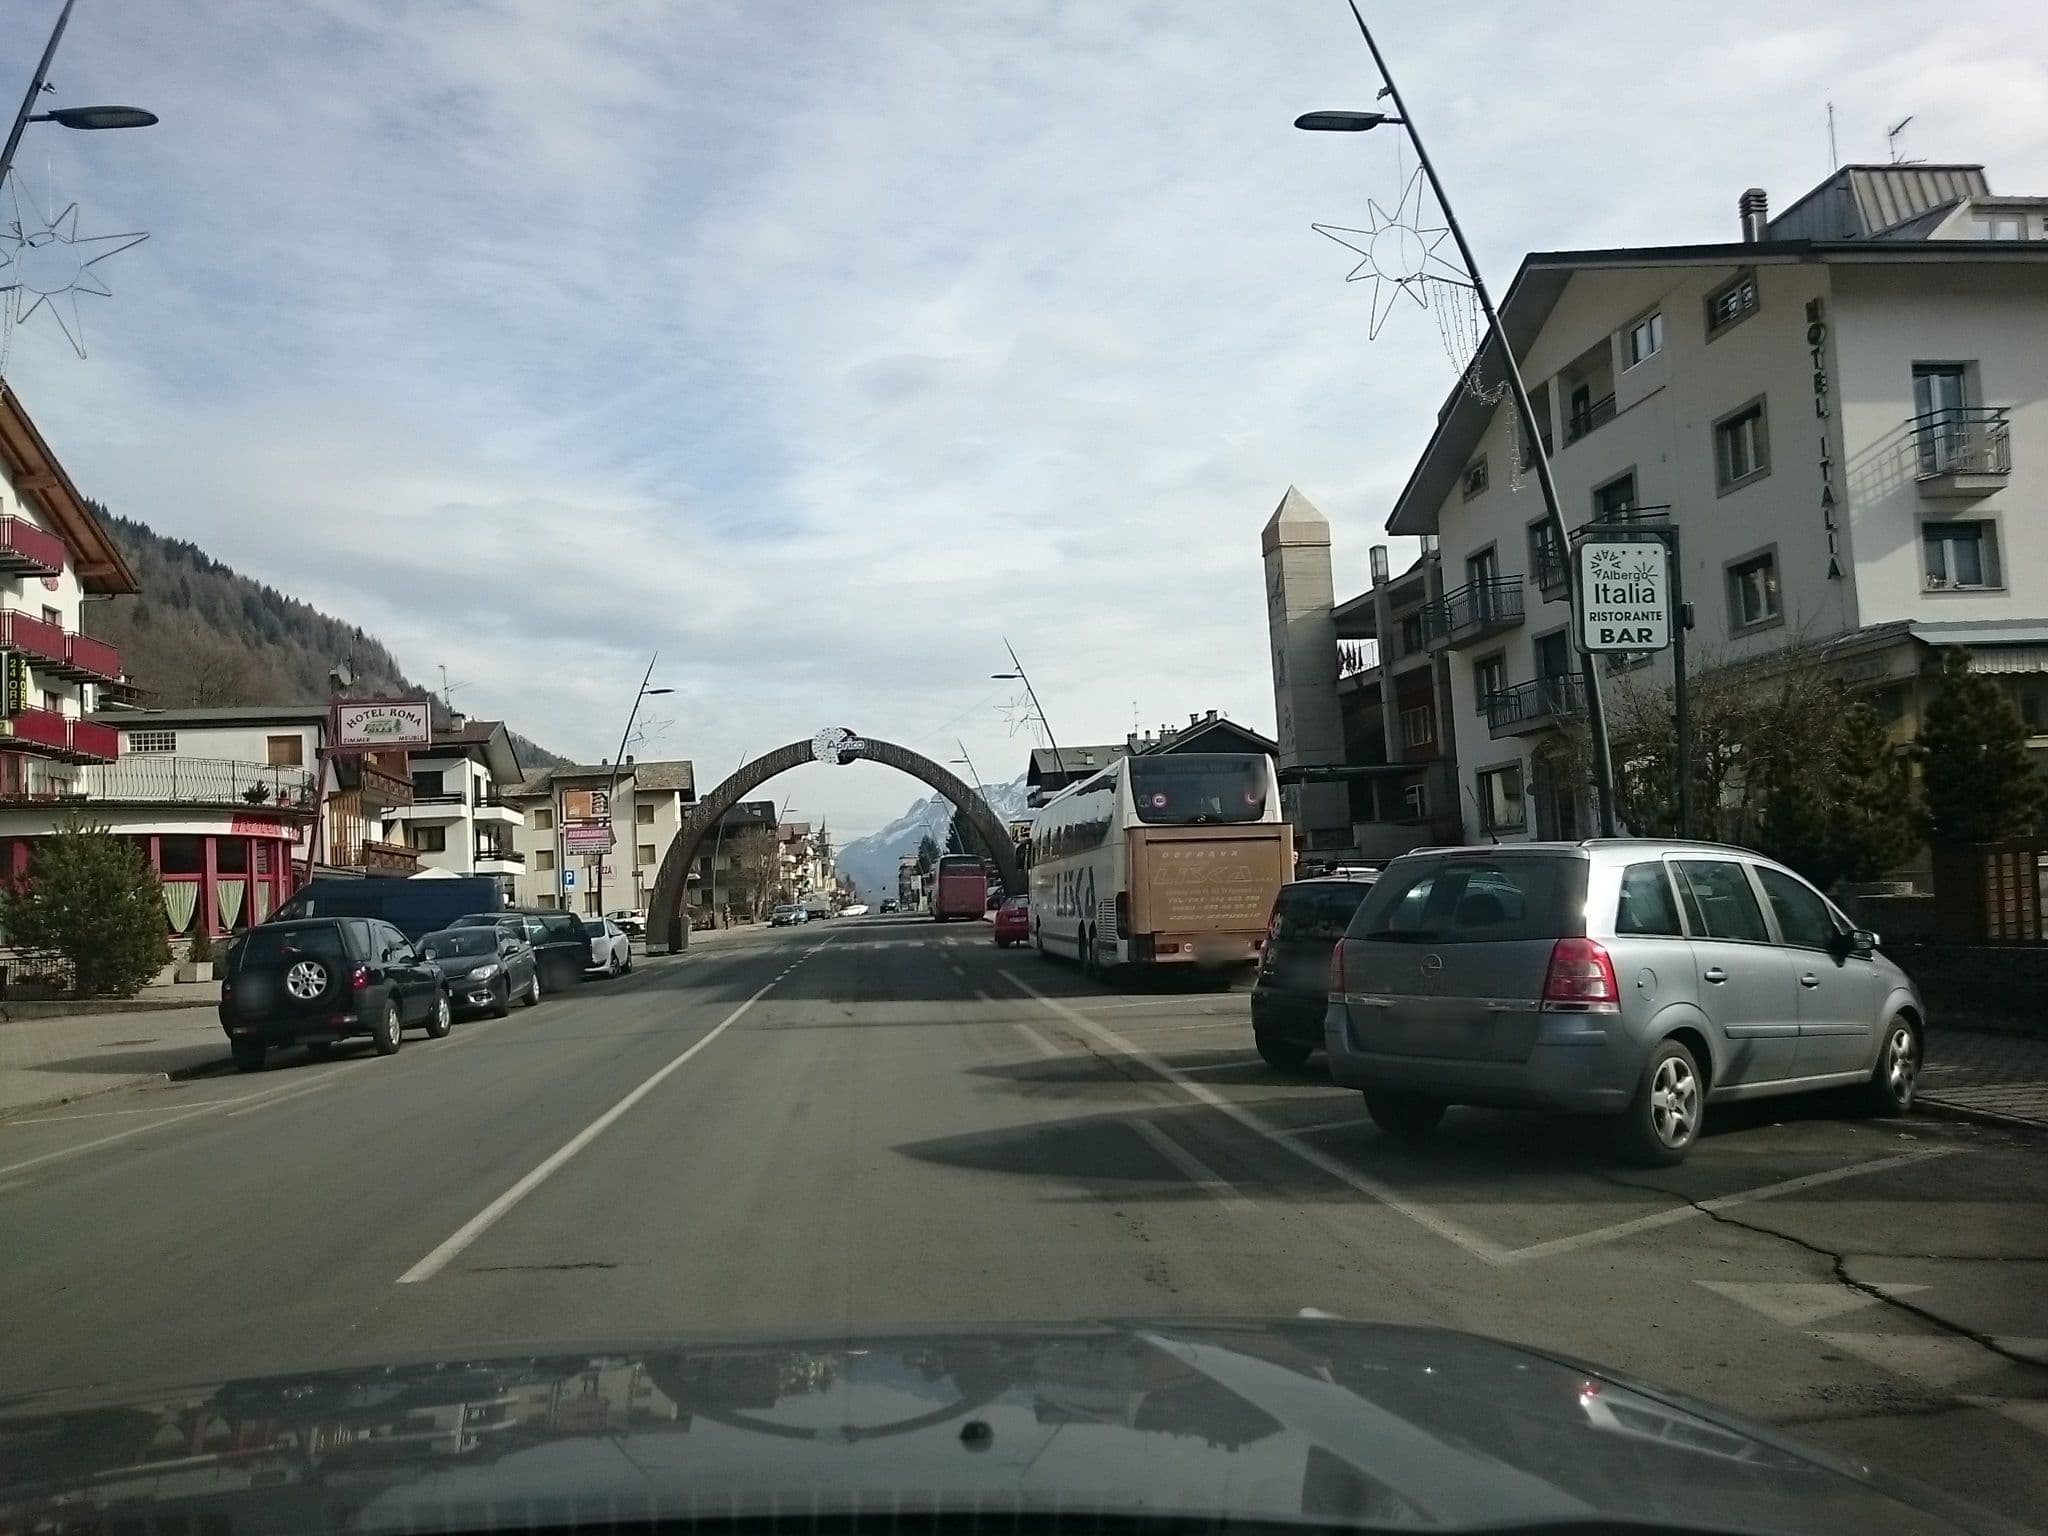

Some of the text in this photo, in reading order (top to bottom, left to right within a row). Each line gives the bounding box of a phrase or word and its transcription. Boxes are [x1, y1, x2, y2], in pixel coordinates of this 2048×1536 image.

[1806, 299, 1841, 580] HOTEL ITALIA
[1602, 570, 1649, 582] Albergo
[1595, 583, 1656, 604] Italia
[1590, 611, 1662, 622] RISTORANTE
[1600, 628, 1653, 643] BAR
[9, 680, 18, 710] ORE
[346, 708, 422, 728] HOTEL ROMA
[827, 737, 864, 754] Aprica
[566, 872, 573, 884] P
[596, 866, 612, 874] PZZA
